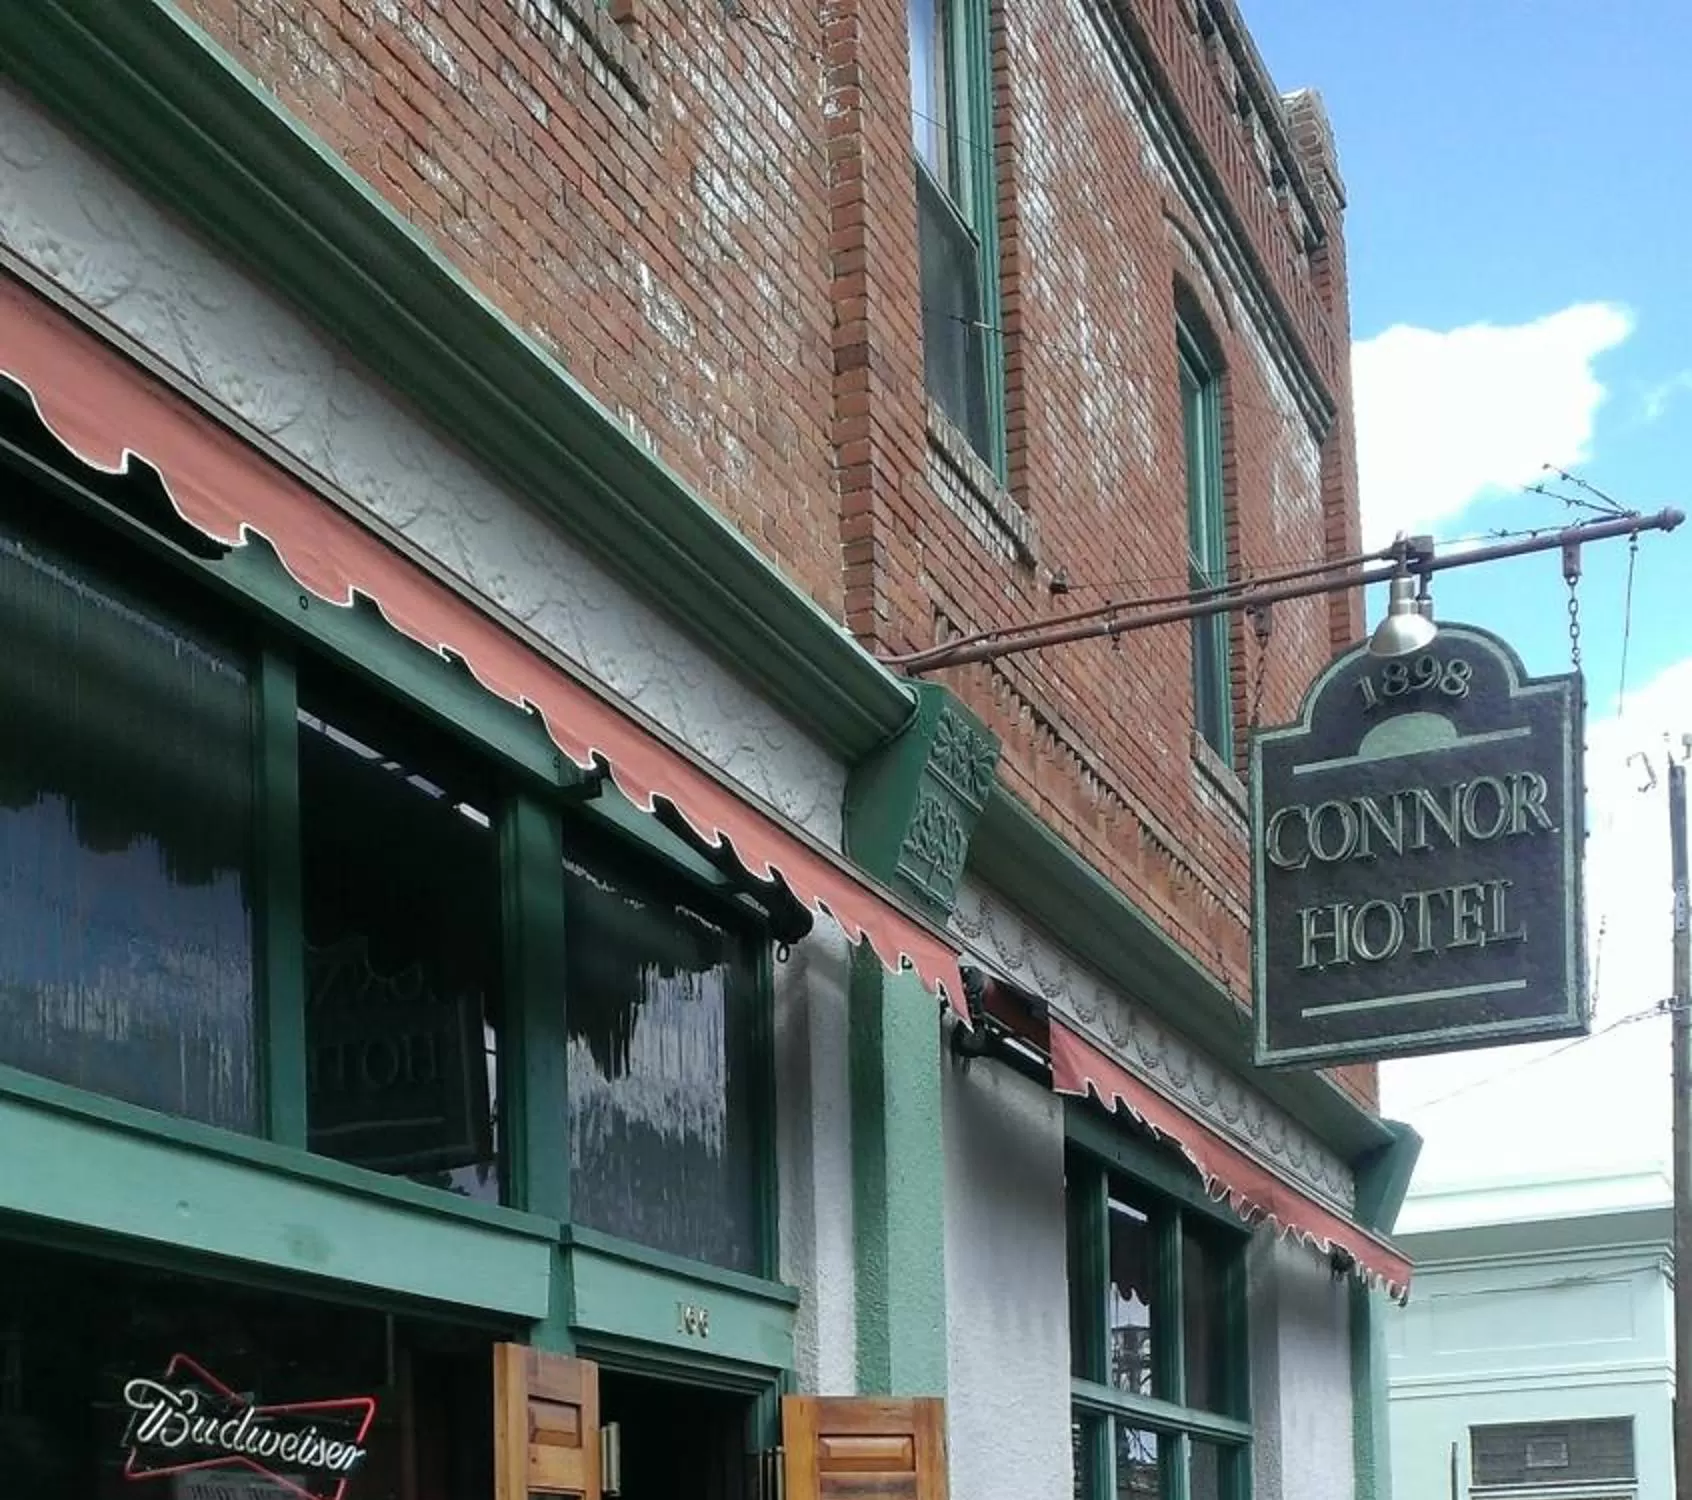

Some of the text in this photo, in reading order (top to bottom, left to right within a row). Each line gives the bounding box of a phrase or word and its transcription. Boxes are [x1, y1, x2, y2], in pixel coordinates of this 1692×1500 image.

[1353, 654, 1474, 710] 1898
[1265, 770, 1560, 871] CONNOR
[1296, 879, 1529, 972] HOTEL
[123, 1378, 367, 1472] Budweiser
